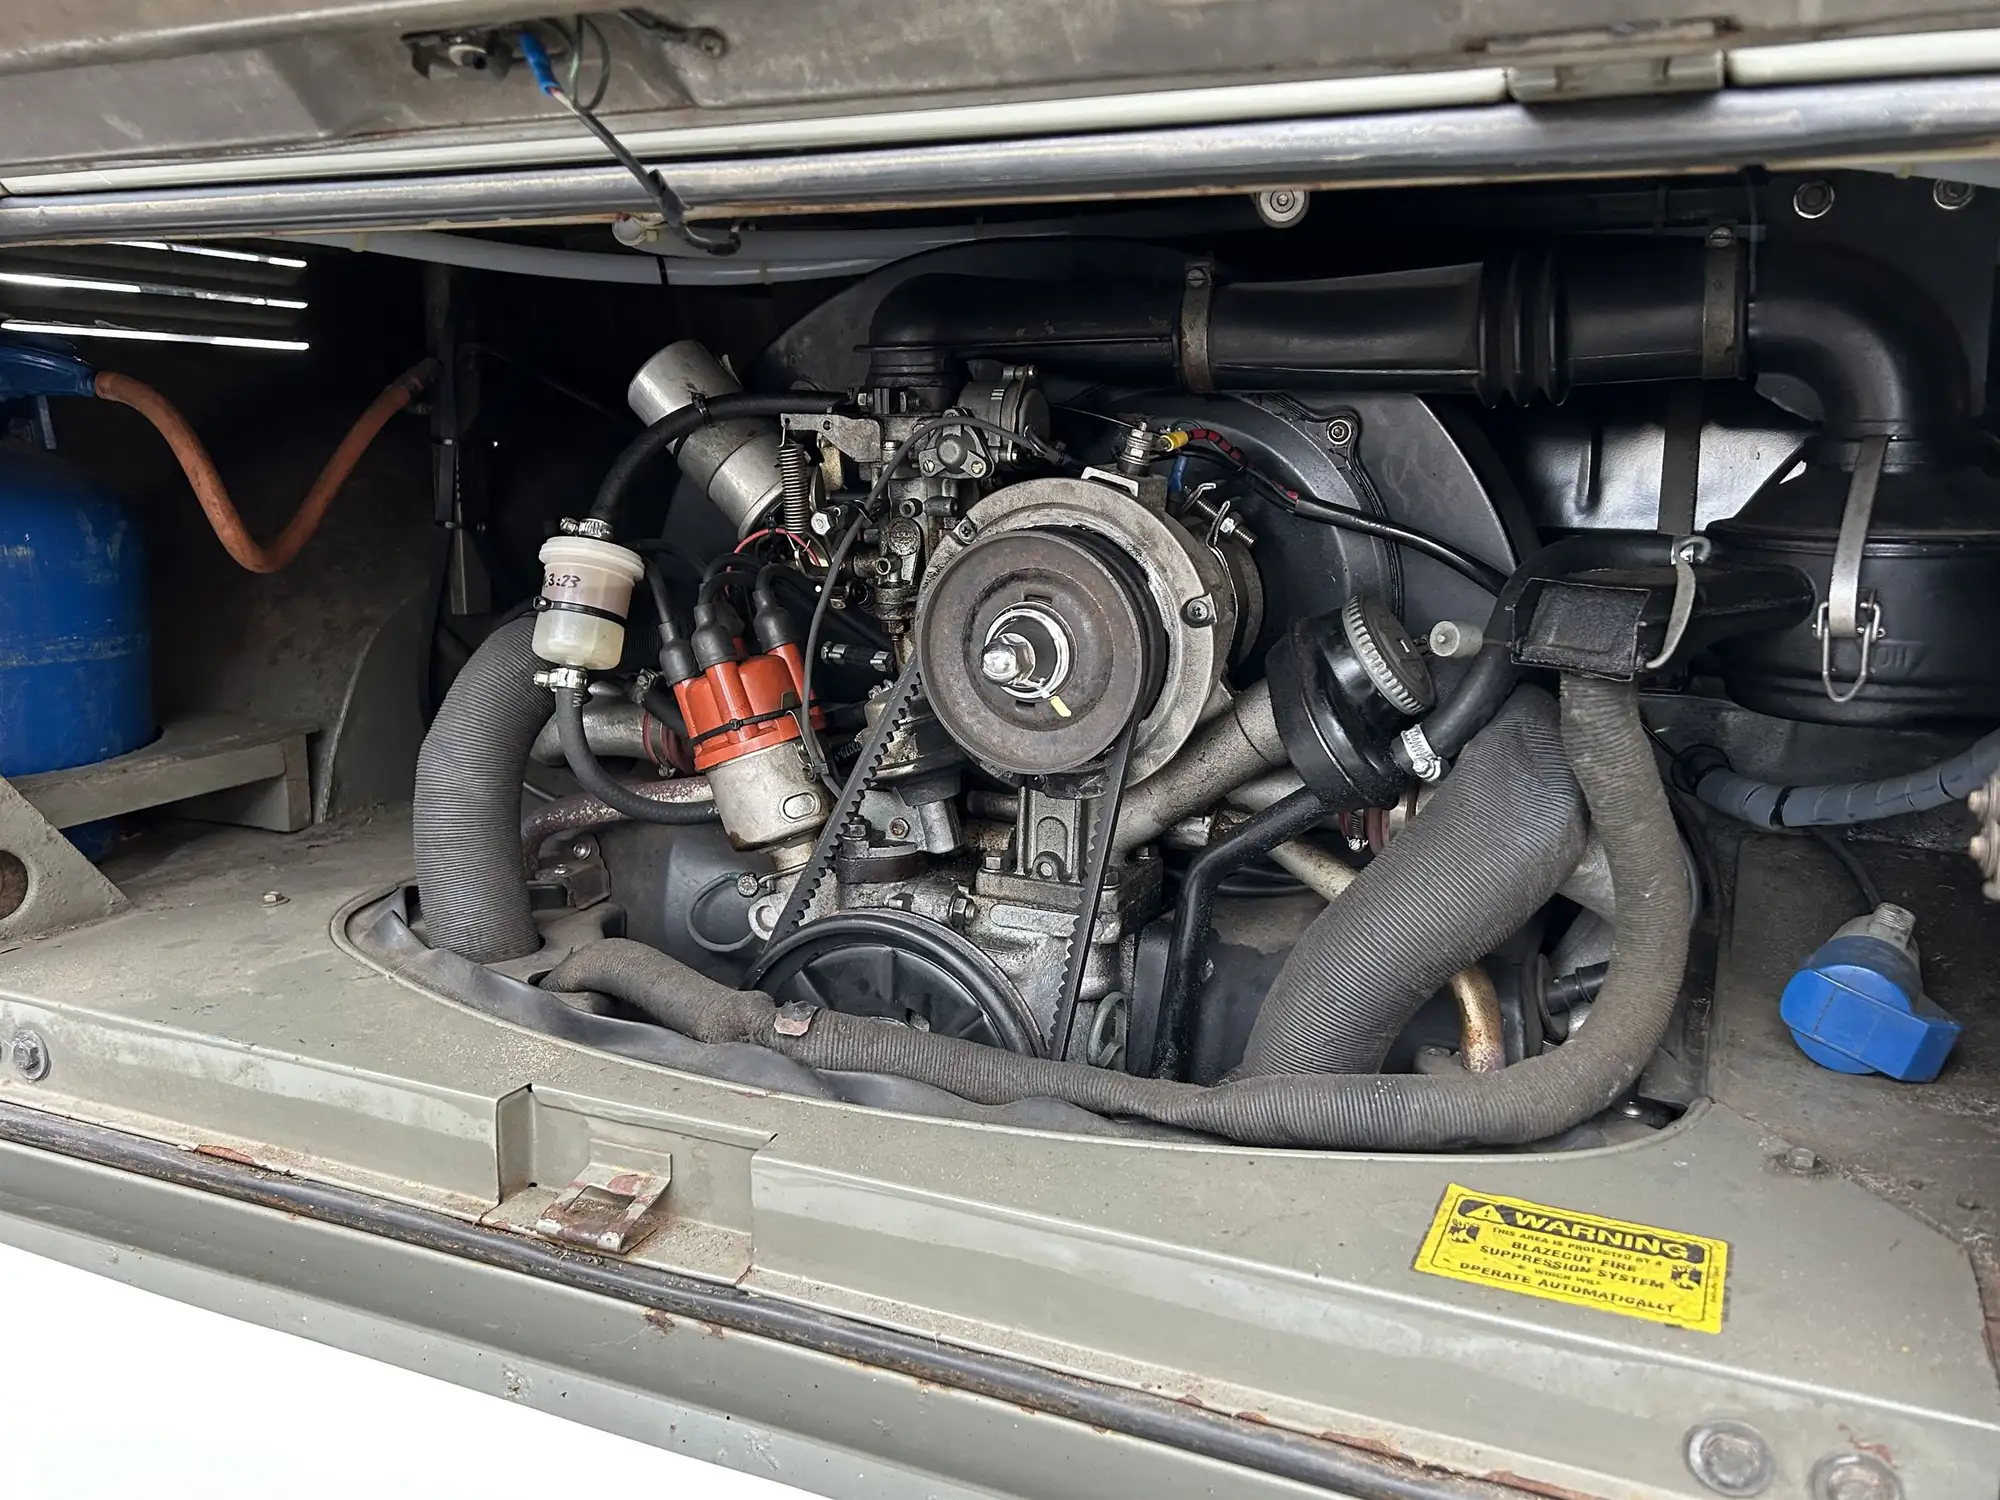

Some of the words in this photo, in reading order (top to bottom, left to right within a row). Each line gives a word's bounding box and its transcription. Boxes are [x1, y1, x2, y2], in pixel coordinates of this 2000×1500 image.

[1493, 1227, 1515, 1237] THIS
[1520, 1233, 1548, 1244] AREA
[1552, 1239, 1563, 1247] IS
[1567, 1242, 1632, 1261] PROTECTED
[1635, 1256, 1650, 1264] BY
[1515, 1211, 1688, 1258] WARNING
[1479, 1245, 1591, 1273] SUPPRESSION
[1597, 1269, 1665, 1289] SYSTEM
[1511, 1241, 1594, 1265] BLAZECUT
[1600, 1259, 1637, 1272] FIRE
[1534, 1268, 1571, 1281] WHICH
[1576, 1276, 1602, 1285] WILL
[1459, 1261, 1532, 1285] OPERATE
[1538, 1278, 1675, 1312] AUTOMATICALLY
